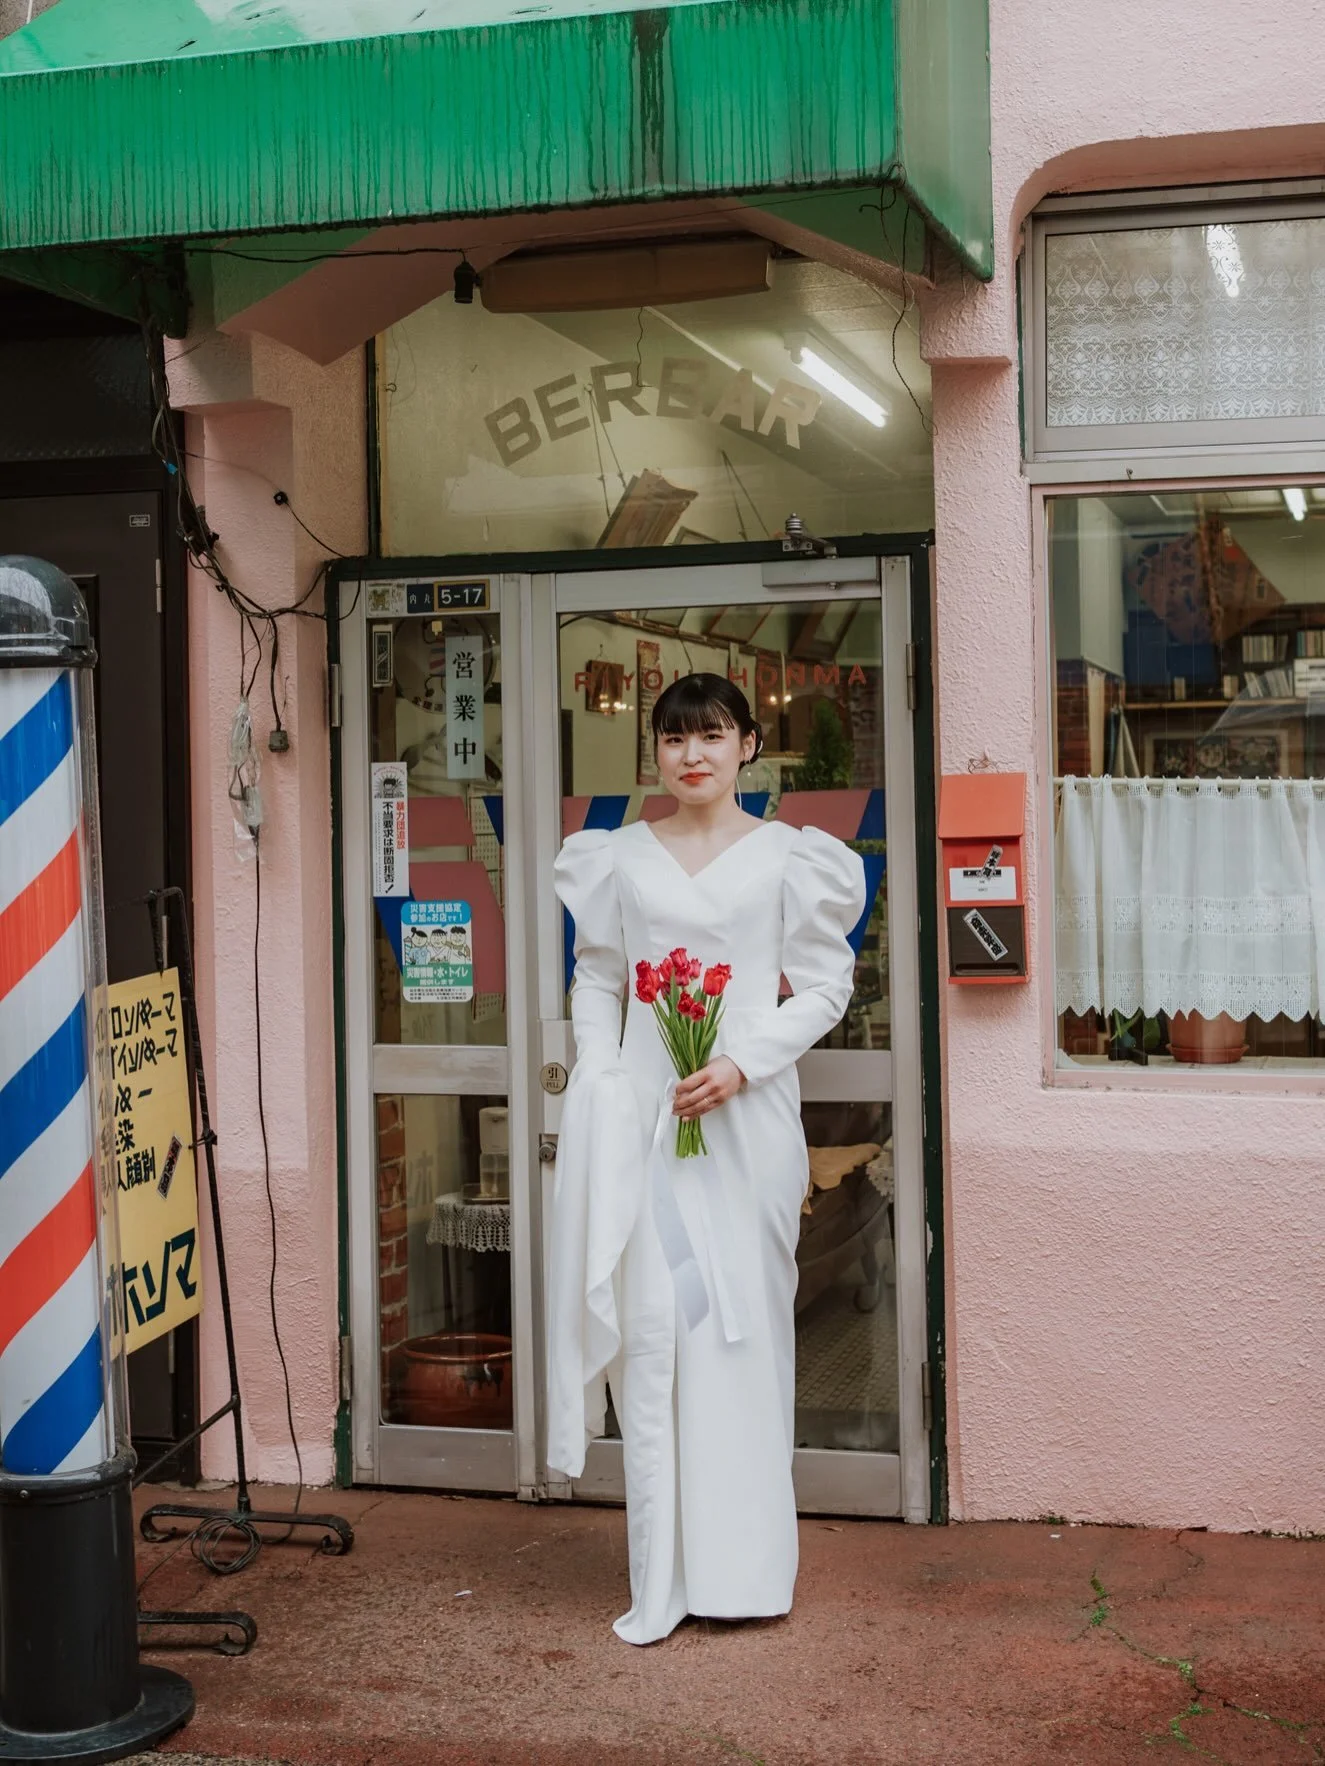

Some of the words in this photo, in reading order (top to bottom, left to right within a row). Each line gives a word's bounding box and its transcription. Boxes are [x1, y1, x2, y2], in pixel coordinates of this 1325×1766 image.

[484, 356, 822, 467] BERBAR
[440, 588, 483, 605] 5-17
[729, 662, 868, 689] HONMA
[452, 650, 477, 766] 営業中
[548, 1067, 558, 1079] 引
